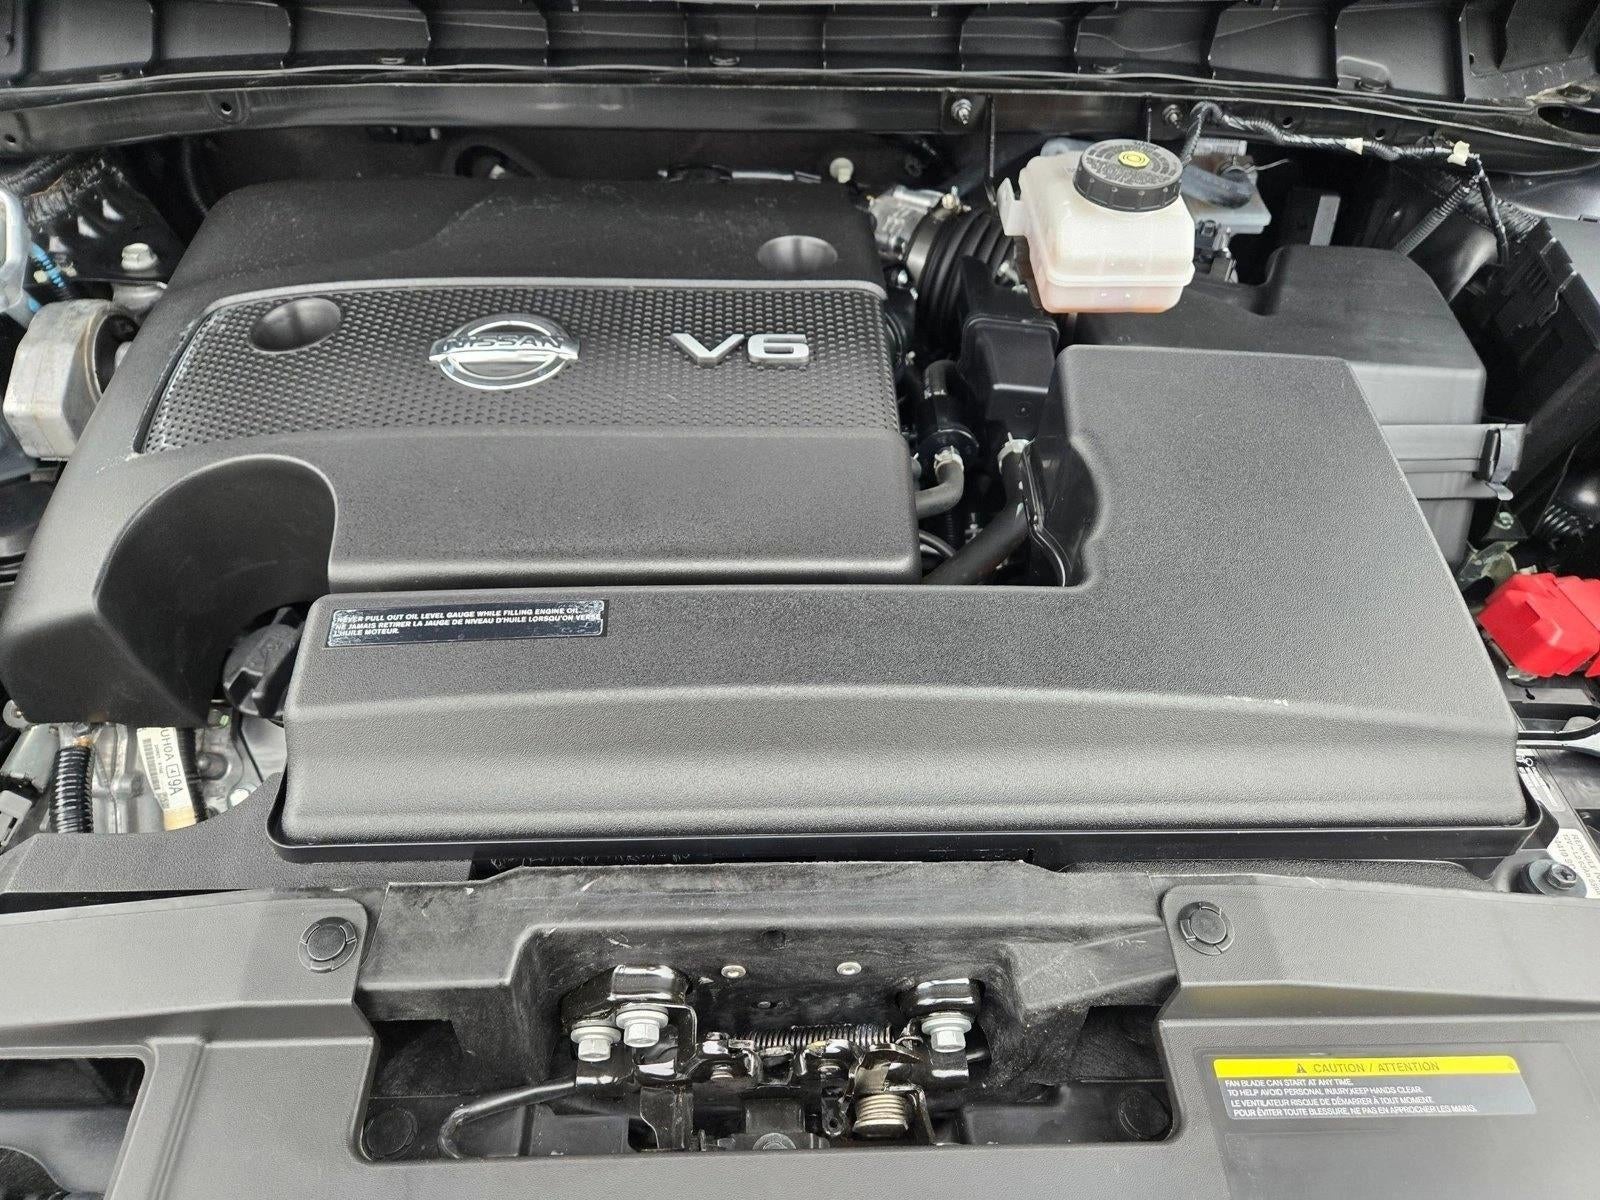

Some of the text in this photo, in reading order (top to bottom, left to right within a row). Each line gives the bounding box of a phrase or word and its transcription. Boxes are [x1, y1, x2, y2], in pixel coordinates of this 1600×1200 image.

[442, 334, 564, 350] NISSAN
[671, 332, 810, 365] V6
[337, 614, 363, 623] NEVER
[365, 614, 384, 622] PULL
[387, 613, 404, 621] OUT
[421, 611, 445, 620] LEVEL
[446, 610, 475, 619] GAUGE
[477, 609, 501, 618] WHILE
[503, 608, 533, 617] FILLING
[535, 607, 565, 616] ENGINE
[348, 622, 377, 630] JAMAIS
[378, 620, 411, 629] RETIRER
[413, 620, 423, 628] LA
[424, 619, 450, 627] JAUGE
[452, 618, 463, 626] DE
[465, 616, 494, 626] NIVEAU
[495, 616, 526, 624] D'HUILE
[528, 614, 573, 623] LORSQU'ON
[364, 627, 399, 635] MOTEUR.
[1313, 1063, 1365, 1073] CAUTION
[1378, 1061, 1440, 1073] ATTENTION
[1225, 1079, 1240, 1088] FAN
[1240, 1079, 1266, 1087] BLADE
[1266, 1079, 1283, 1087] CAN
[1284, 1078, 1307, 1087] START
[1308, 1078, 1317, 1086] AT
[1319, 1078, 1333, 1086] ANY
[1227, 1088, 1239, 1097] TO
[1239, 1088, 1260, 1097] HELP
[1260, 1088, 1284, 1096] AVOID
[1284, 1087, 1325, 1096] PERSONAL
[1370, 1086, 1397, 1095] HANDS
[1230, 1099, 1240, 1108] LE
[1241, 1098, 1290, 1107] VENTILATEUR
[1291, 1098, 1319, 1107] RISQUE
[1320, 1097, 1331, 1106] DE
[1380, 1096, 1399, 1105] TOUT
[1233, 1109, 1256, 1117] POUR
[1256, 1107, 1284, 1117] ÉVITER
[1284, 1108, 1309, 1116] TOUTE
[1350, 1107, 1362, 1115] NE
[1362, 1106, 1378, 1115] PAS
[1379, 1106, 1390, 1114] EN
[1438, 1104, 1451, 1113] LES
